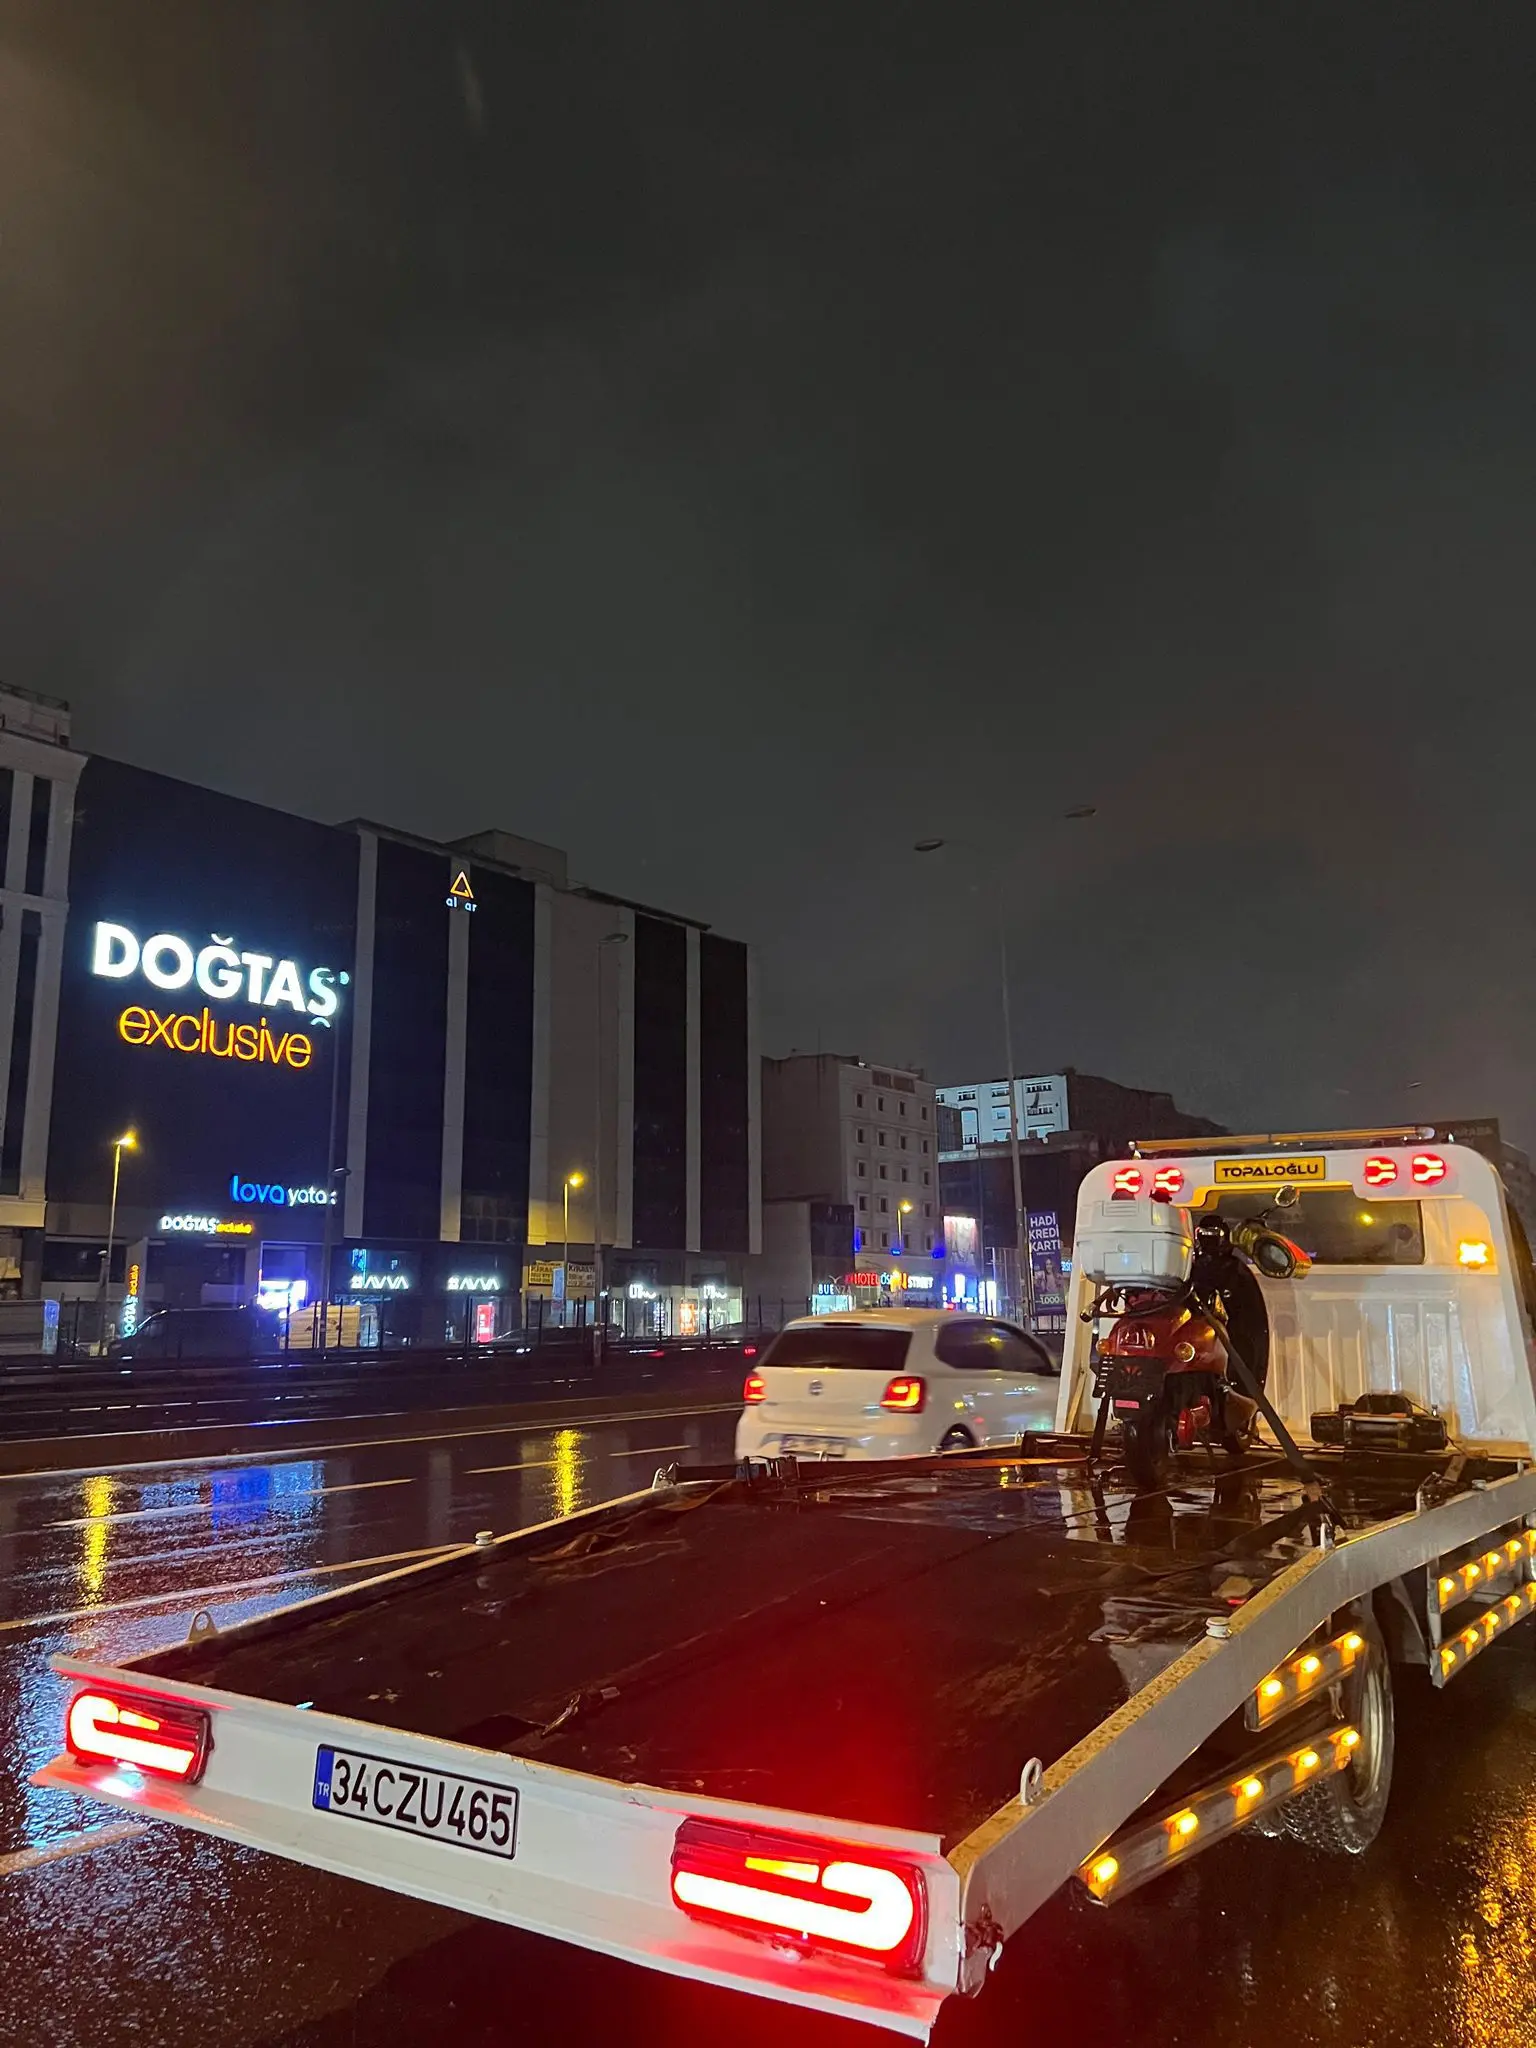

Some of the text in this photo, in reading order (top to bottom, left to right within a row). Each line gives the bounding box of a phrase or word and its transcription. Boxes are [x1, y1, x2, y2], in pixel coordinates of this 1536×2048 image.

[93, 920, 338, 1028] DOĞTAŞ
[118, 1005, 312, 1069] exclusive
[1221, 1163, 1319, 1178] TOPALOĞLU
[231, 1175, 285, 1204] lova
[161, 1214, 218, 1234] DOĞTAŞ
[1030, 1212, 1056, 1228] HADİ
[1029, 1224, 1060, 1240] KREDİ
[1030, 1239, 1061, 1252] KARTI
[854, 1272, 880, 1287] HOTEL
[318, 1758, 513, 1847] TR 34CZU465
